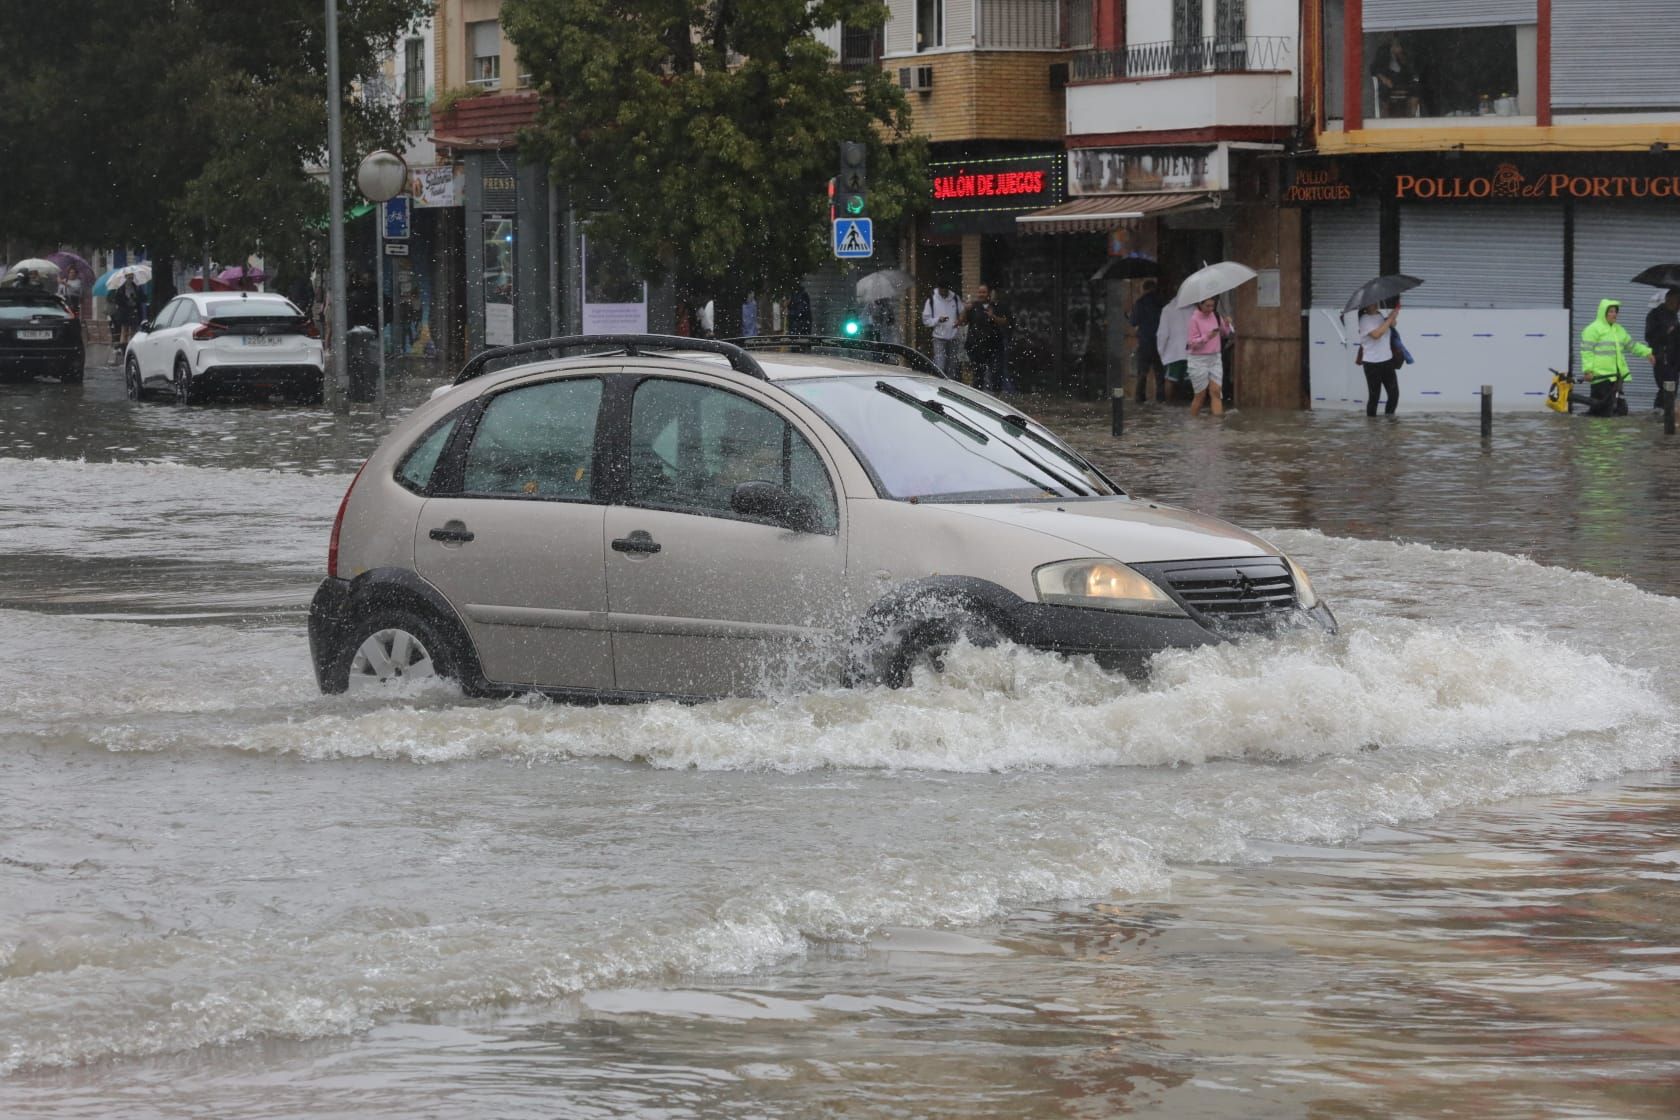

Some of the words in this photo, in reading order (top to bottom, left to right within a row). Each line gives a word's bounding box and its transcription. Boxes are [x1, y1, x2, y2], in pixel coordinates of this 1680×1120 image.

[934, 168, 974, 199] SALÓN
[977, 175, 994, 196] DE
[995, 171, 1043, 195] JUEGOS
[1395, 175, 1491, 198] POLLO
[1523, 175, 1546, 198] el
